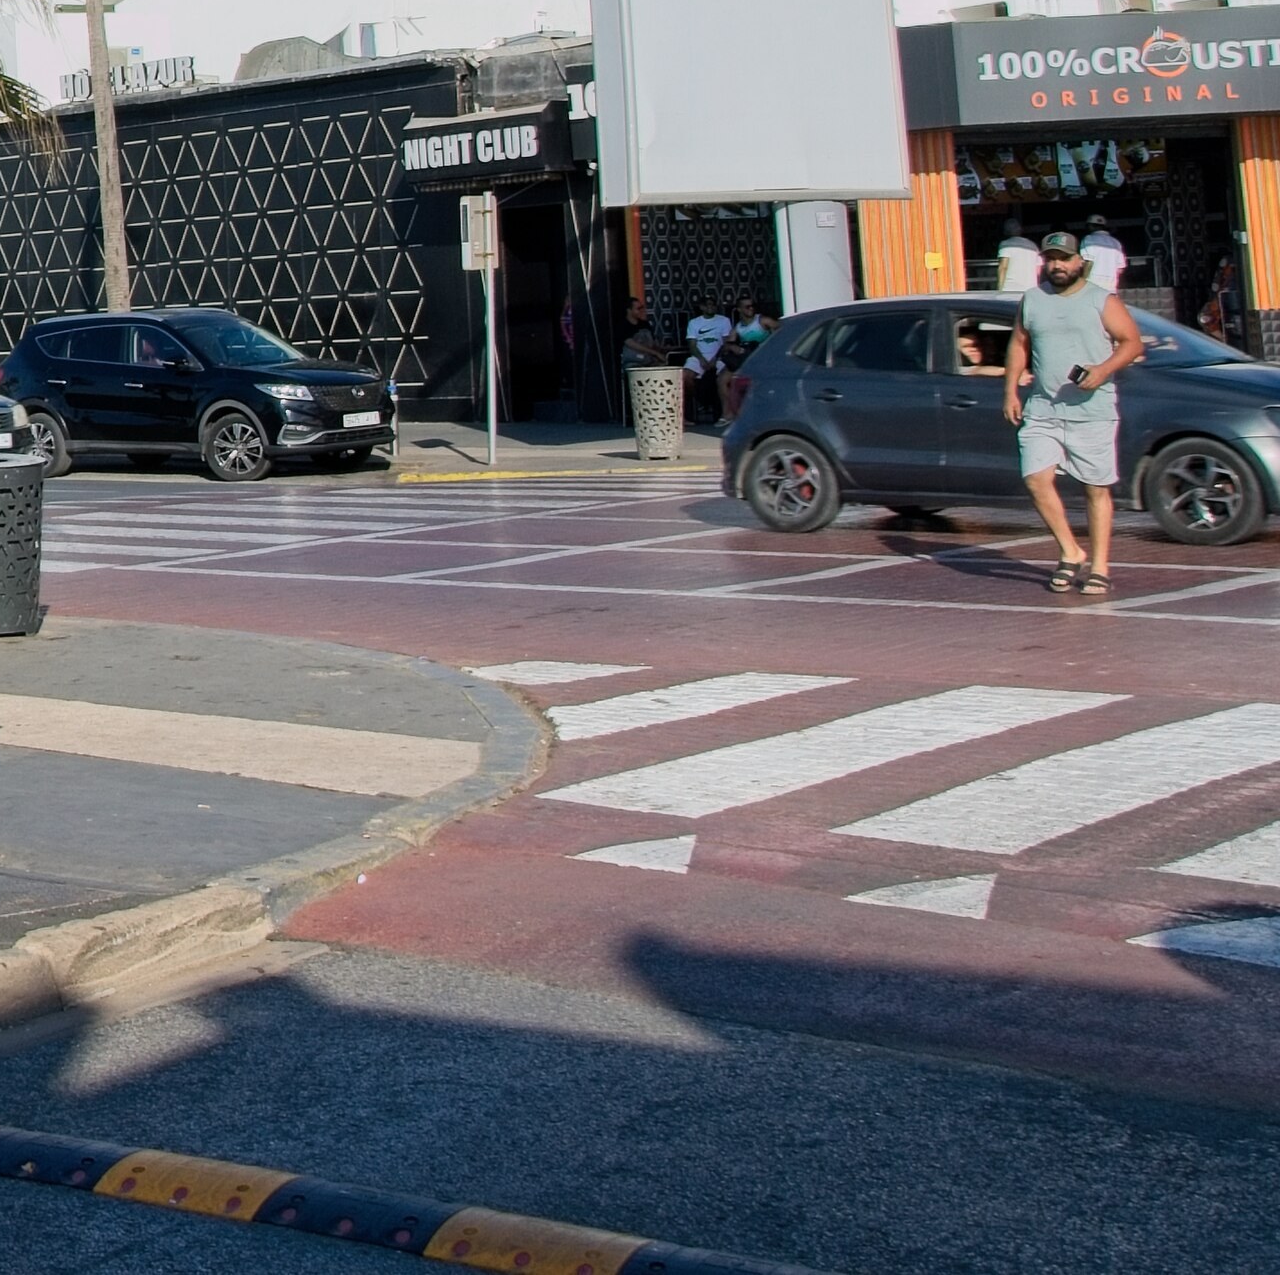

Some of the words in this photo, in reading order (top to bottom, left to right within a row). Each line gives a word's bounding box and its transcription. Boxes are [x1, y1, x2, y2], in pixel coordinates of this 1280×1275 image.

[130, 56, 196, 92] AZUR
[1030, 81, 1240, 109] ORIGINAL
[403, 132, 474, 171] NIGHT
[475, 124, 539, 163] CLUB
